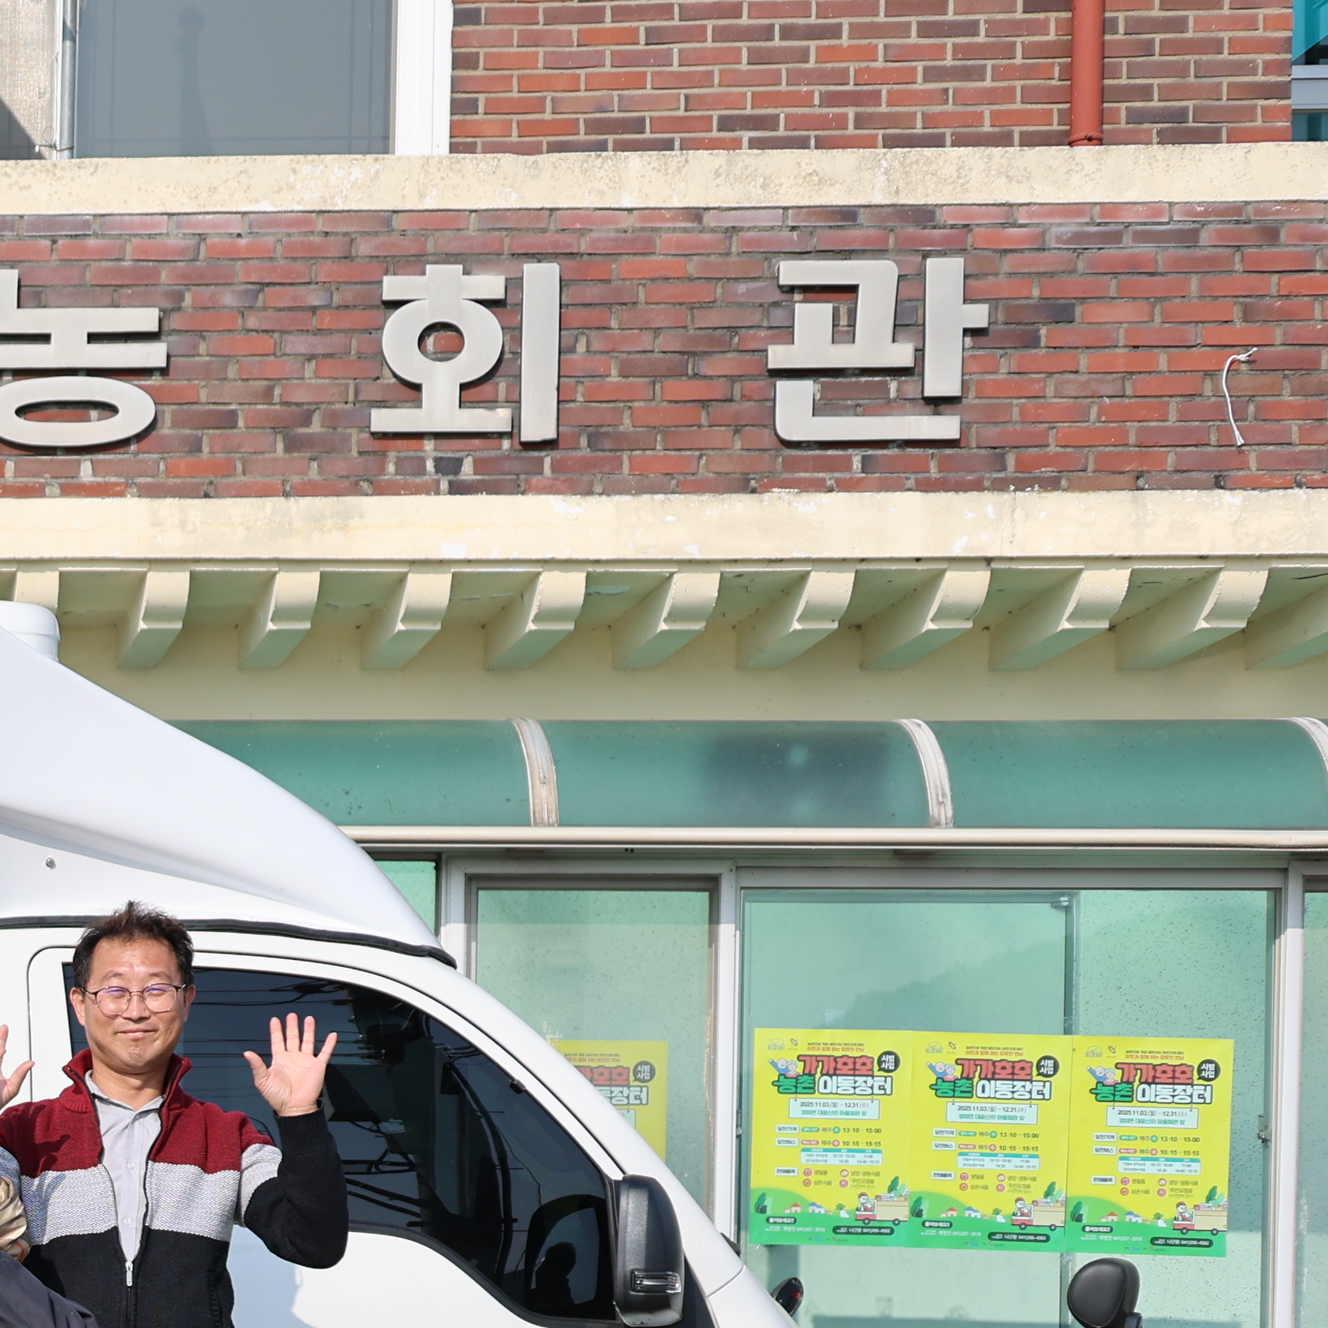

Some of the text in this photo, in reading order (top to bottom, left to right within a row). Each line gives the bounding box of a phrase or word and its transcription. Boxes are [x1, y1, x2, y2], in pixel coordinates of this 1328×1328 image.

[798, 1055, 874, 1075] 가가호호
[956, 1059, 1033, 1079] 가가호호
[1116, 1063, 1193, 1083] 가가호호
[1200, 1070, 1215, 1078] 사업
[773, 1075, 892, 1095] 농촌 이동장터
[931, 1079, 1051, 1099] 농촌 이동장터
[1091, 1083, 1212, 1103] 농촌 이동장터
